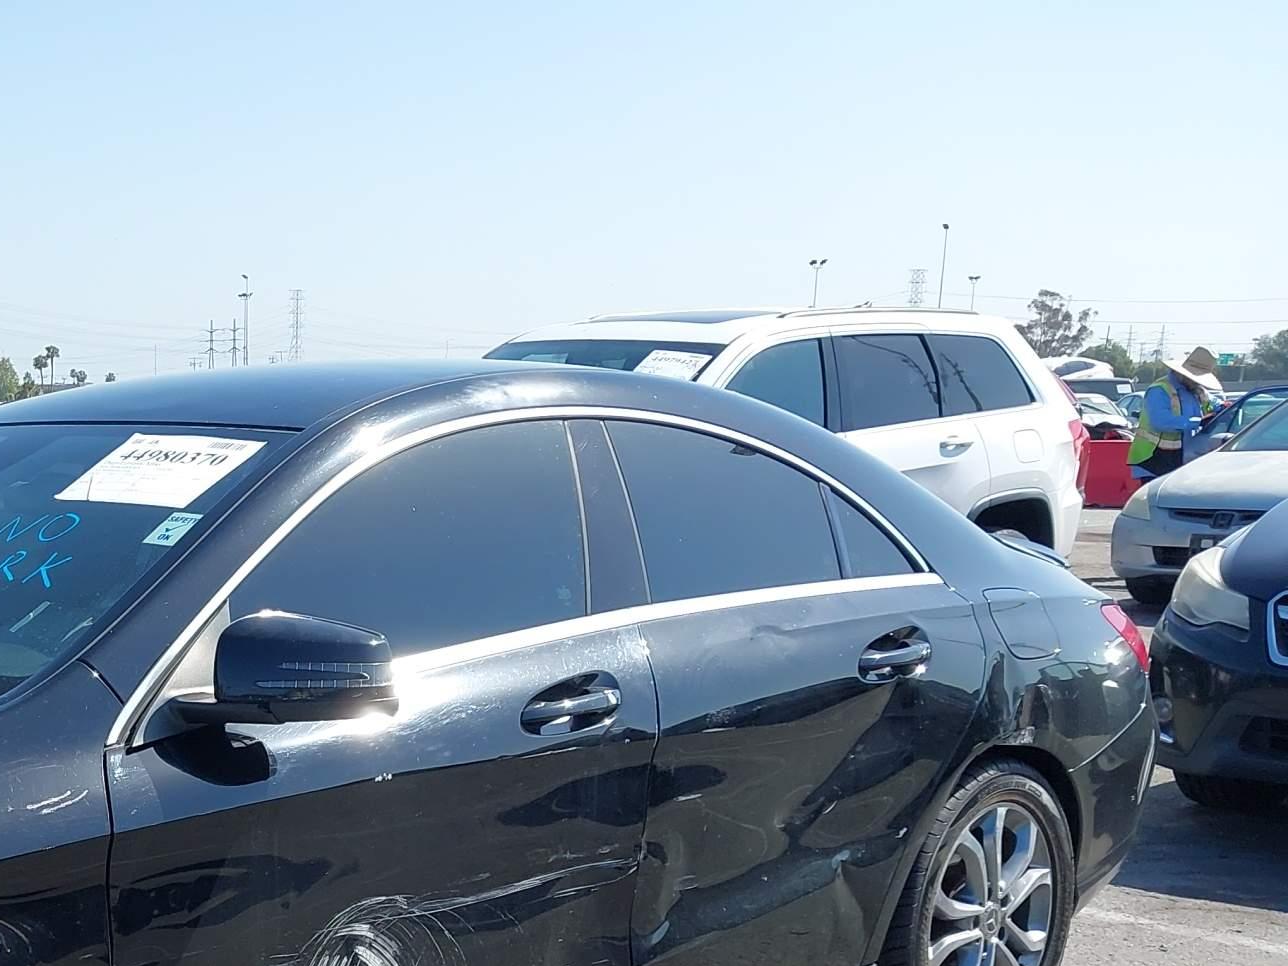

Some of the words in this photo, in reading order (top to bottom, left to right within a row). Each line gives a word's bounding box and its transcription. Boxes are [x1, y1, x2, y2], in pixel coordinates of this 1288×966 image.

[121, 448, 229, 467] 44980370
[167, 516, 199, 524] SAFETY
[157, 533, 173, 541] OK
